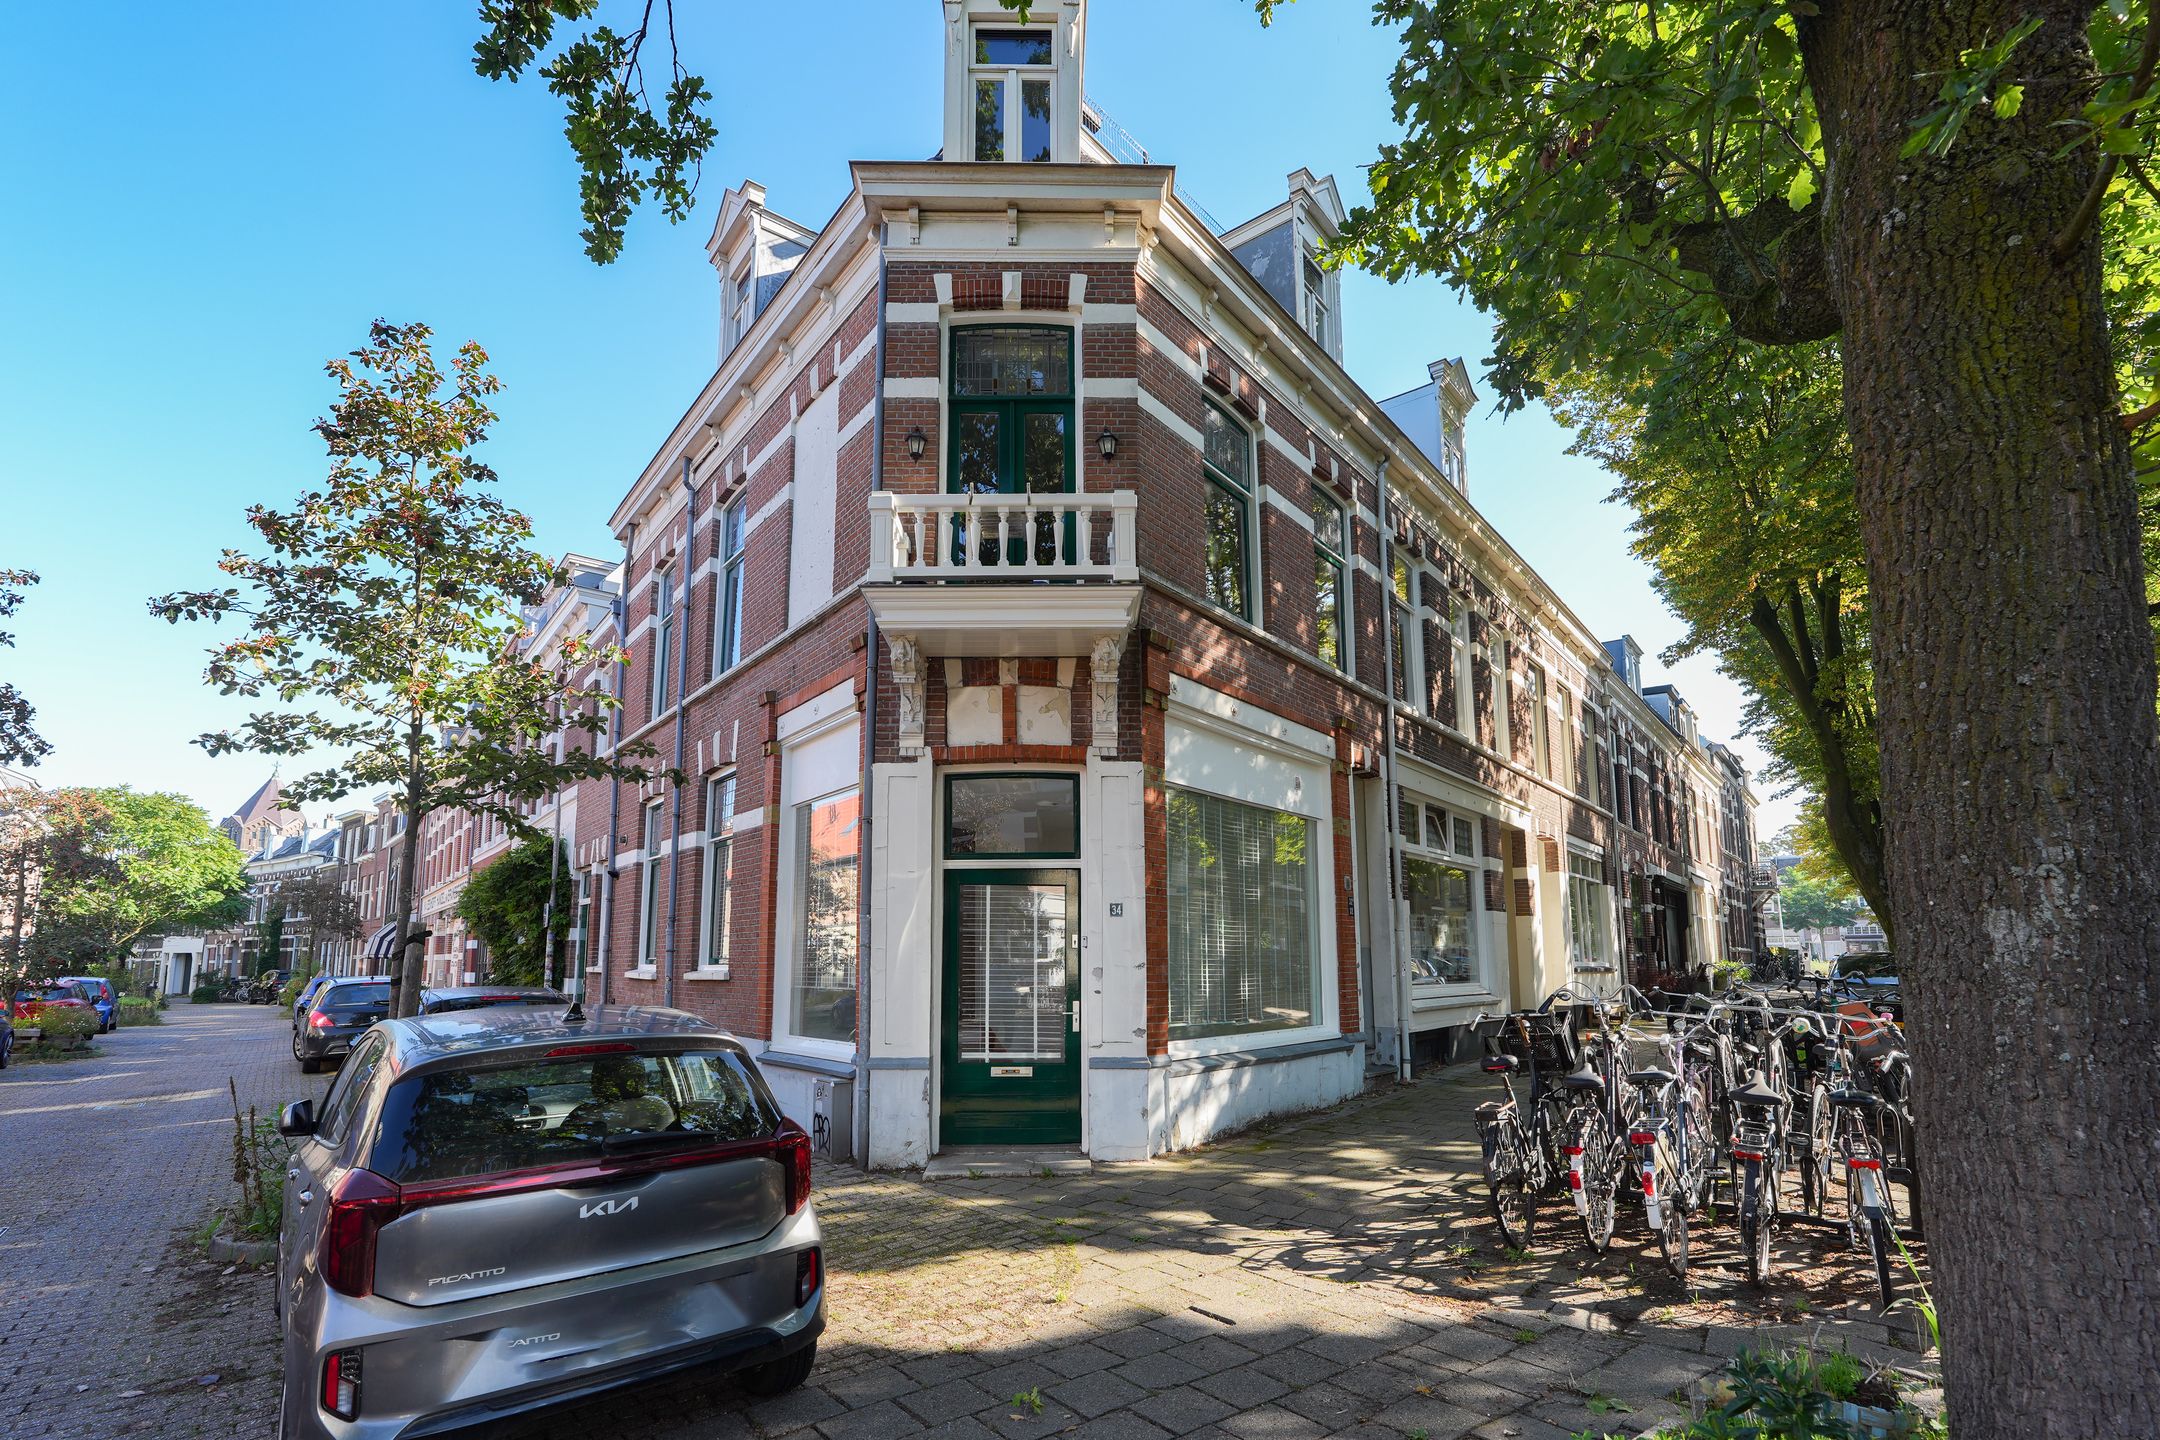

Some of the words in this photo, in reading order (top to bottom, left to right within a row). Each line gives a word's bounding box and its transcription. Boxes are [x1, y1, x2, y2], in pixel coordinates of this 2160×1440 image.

[1111, 904, 1122, 915] 34
[579, 1196, 639, 1219] KIA
[428, 1266, 506, 1287] PICANTO
